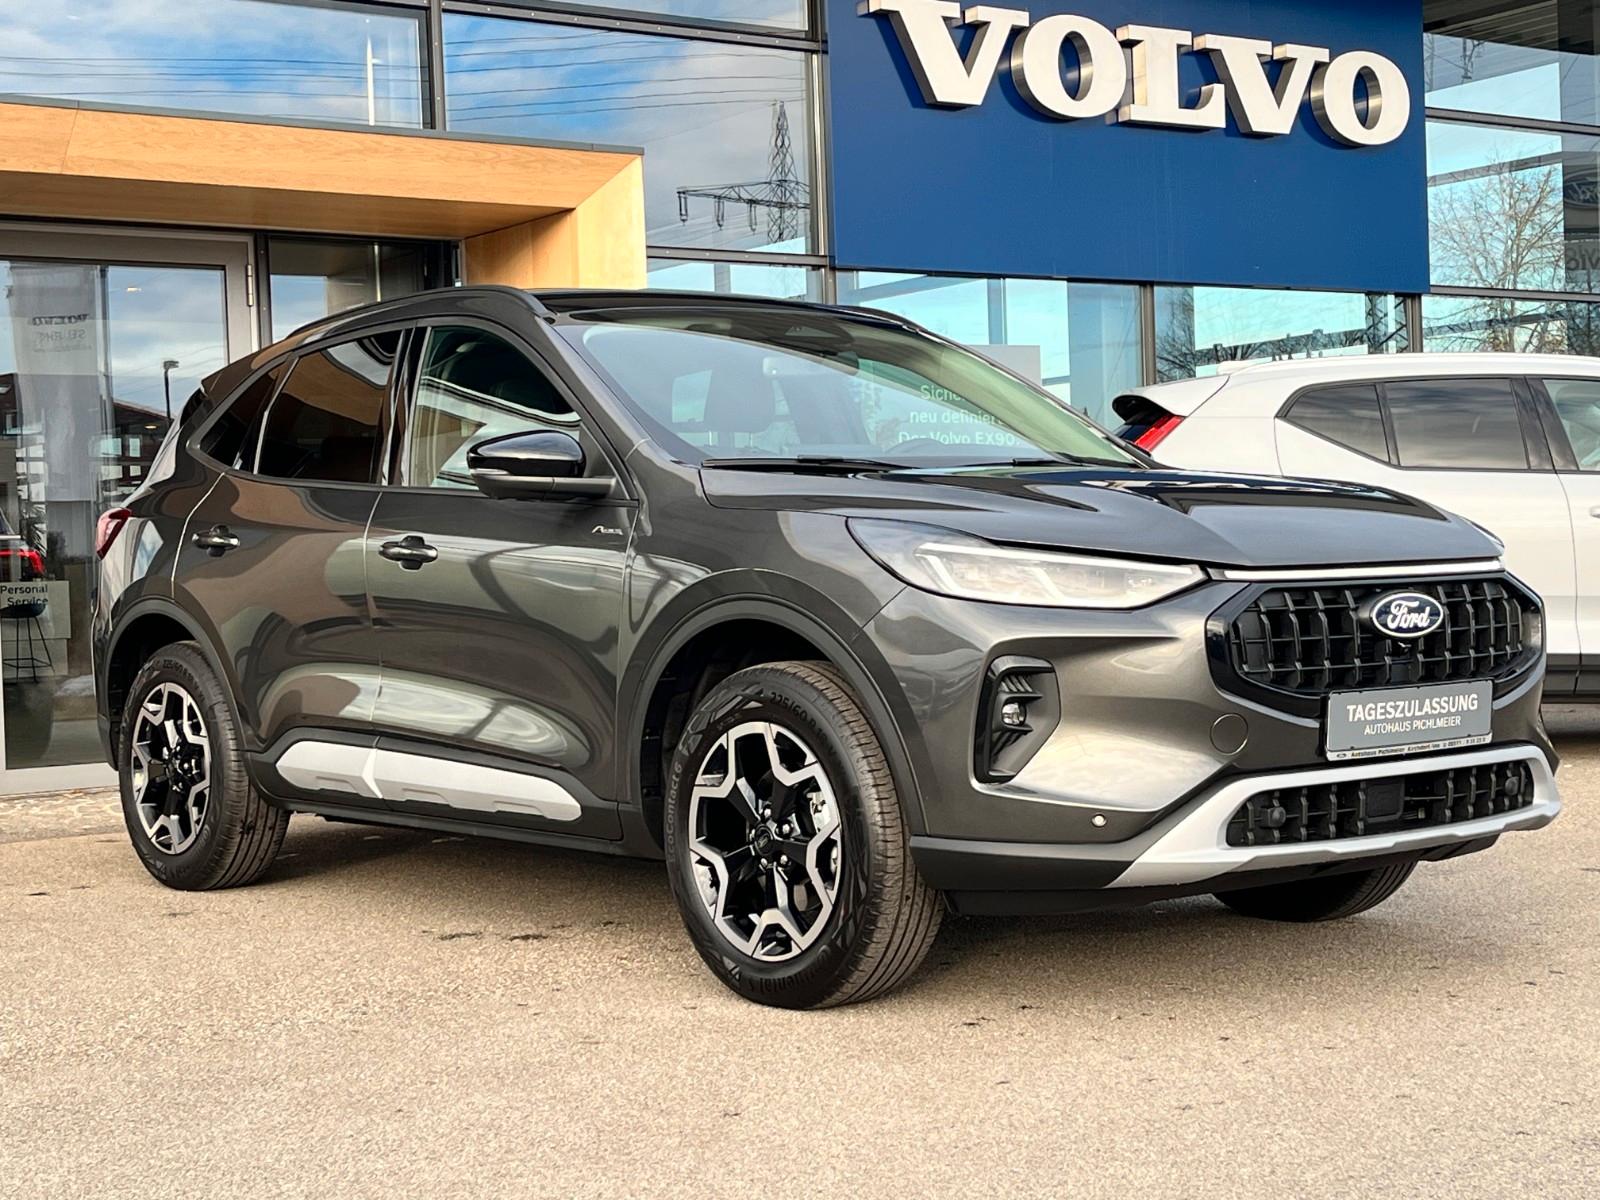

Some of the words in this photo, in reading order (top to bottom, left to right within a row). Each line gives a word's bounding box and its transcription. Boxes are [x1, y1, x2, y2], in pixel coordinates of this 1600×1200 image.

[858, 0, 1411, 146] VOLVO
[910, 411, 937, 423] neu
[929, 431, 970, 445] Volvo
[0, 584, 48, 594] Personal
[1387, 600, 1431, 629] Ford
[1346, 693, 1478, 722] TAGESZULASSUNG
[1364, 720, 1411, 736] AUTOHAUS
[1413, 715, 1462, 730] PICHLMEIER
